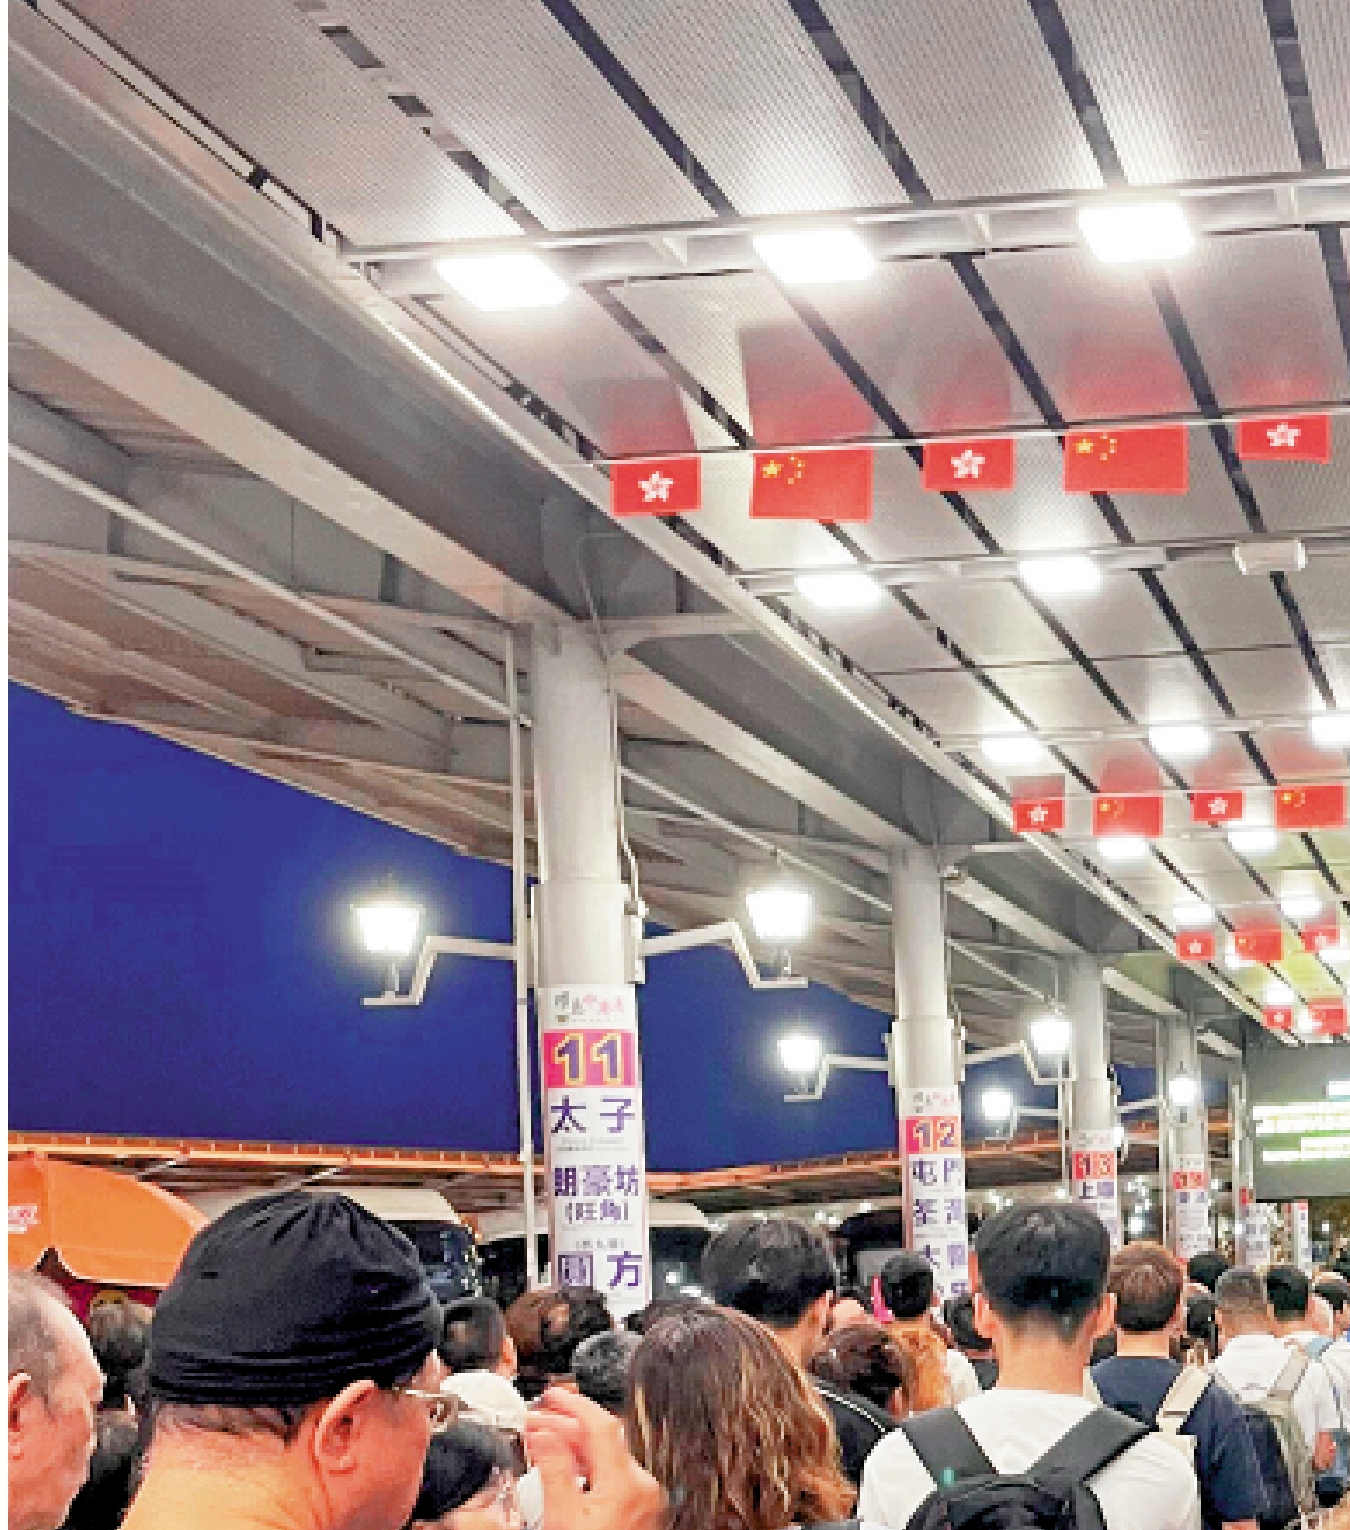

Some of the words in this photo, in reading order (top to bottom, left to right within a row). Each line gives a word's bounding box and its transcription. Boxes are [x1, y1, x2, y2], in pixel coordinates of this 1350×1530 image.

[553, 1032, 626, 1086] 11
[551, 1094, 636, 1133] 太子
[911, 1118, 958, 1153] 12
[554, 1164, 639, 1197] 朗豪坊
